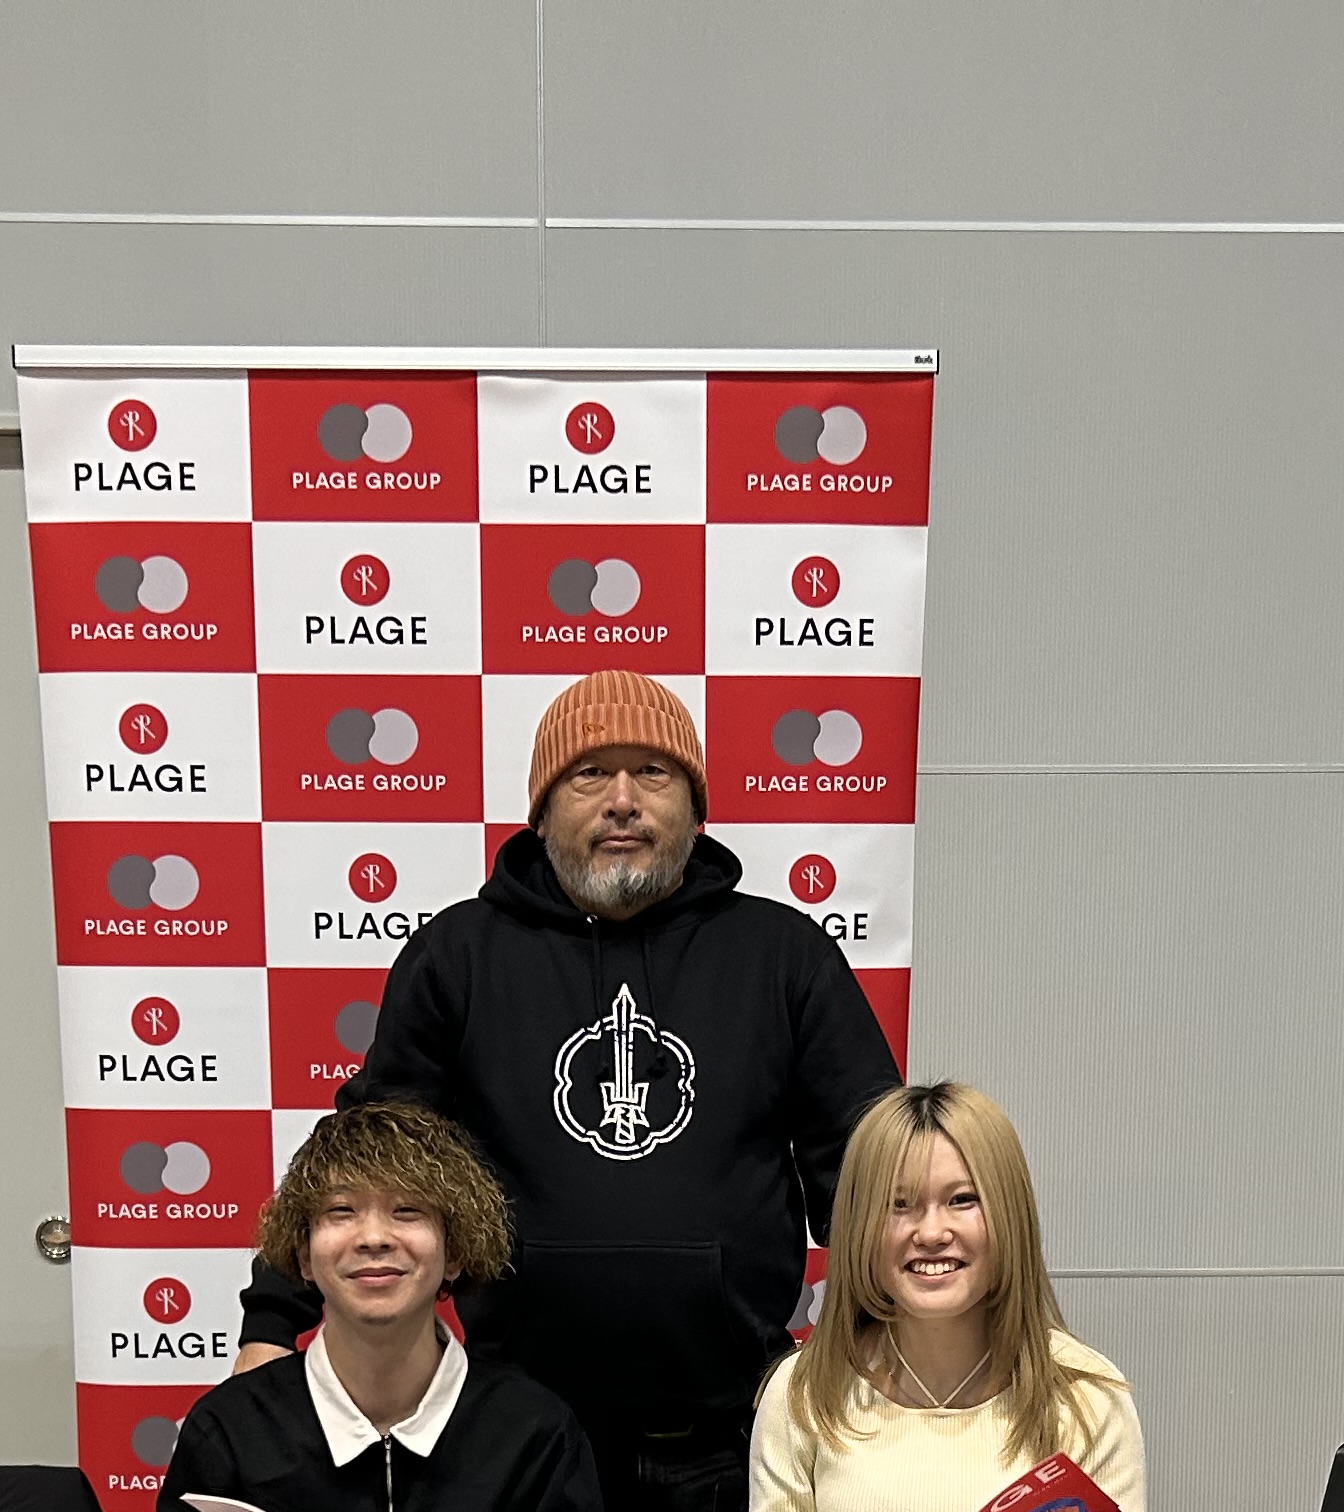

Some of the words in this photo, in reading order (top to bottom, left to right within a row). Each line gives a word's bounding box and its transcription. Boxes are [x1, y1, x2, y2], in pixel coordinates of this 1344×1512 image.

[74, 462, 197, 492] PLAGE
[292, 472, 359, 491] PLAGE
[365, 472, 441, 491] GROUP
[529, 464, 652, 495] PLAGE
[747, 474, 812, 493] PLAGE
[819, 474, 893, 493] GROUP
[71, 623, 135, 641] PLAGE
[141, 623, 218, 641] GROUP
[305, 616, 428, 646] PLAGE
[522, 626, 587, 643] PLAGE
[593, 626, 669, 643] GROUP
[755, 618, 875, 648] PLAGE
[85, 763, 207, 793] PLAGE
[300, 774, 365, 791] PLAGE
[371, 774, 446, 791] GROUP
[745, 776, 809, 792] PLAGE
[816, 776, 887, 792] GROUP
[84, 919, 147, 936] PLAGE
[154, 919, 229, 936] GROUP
[99, 1055, 217, 1082] PLAGE
[97, 1204, 158, 1220] PLAGE
[165, 1203, 239, 1220] GROUP
[111, 1332, 228, 1359] PLAGE
